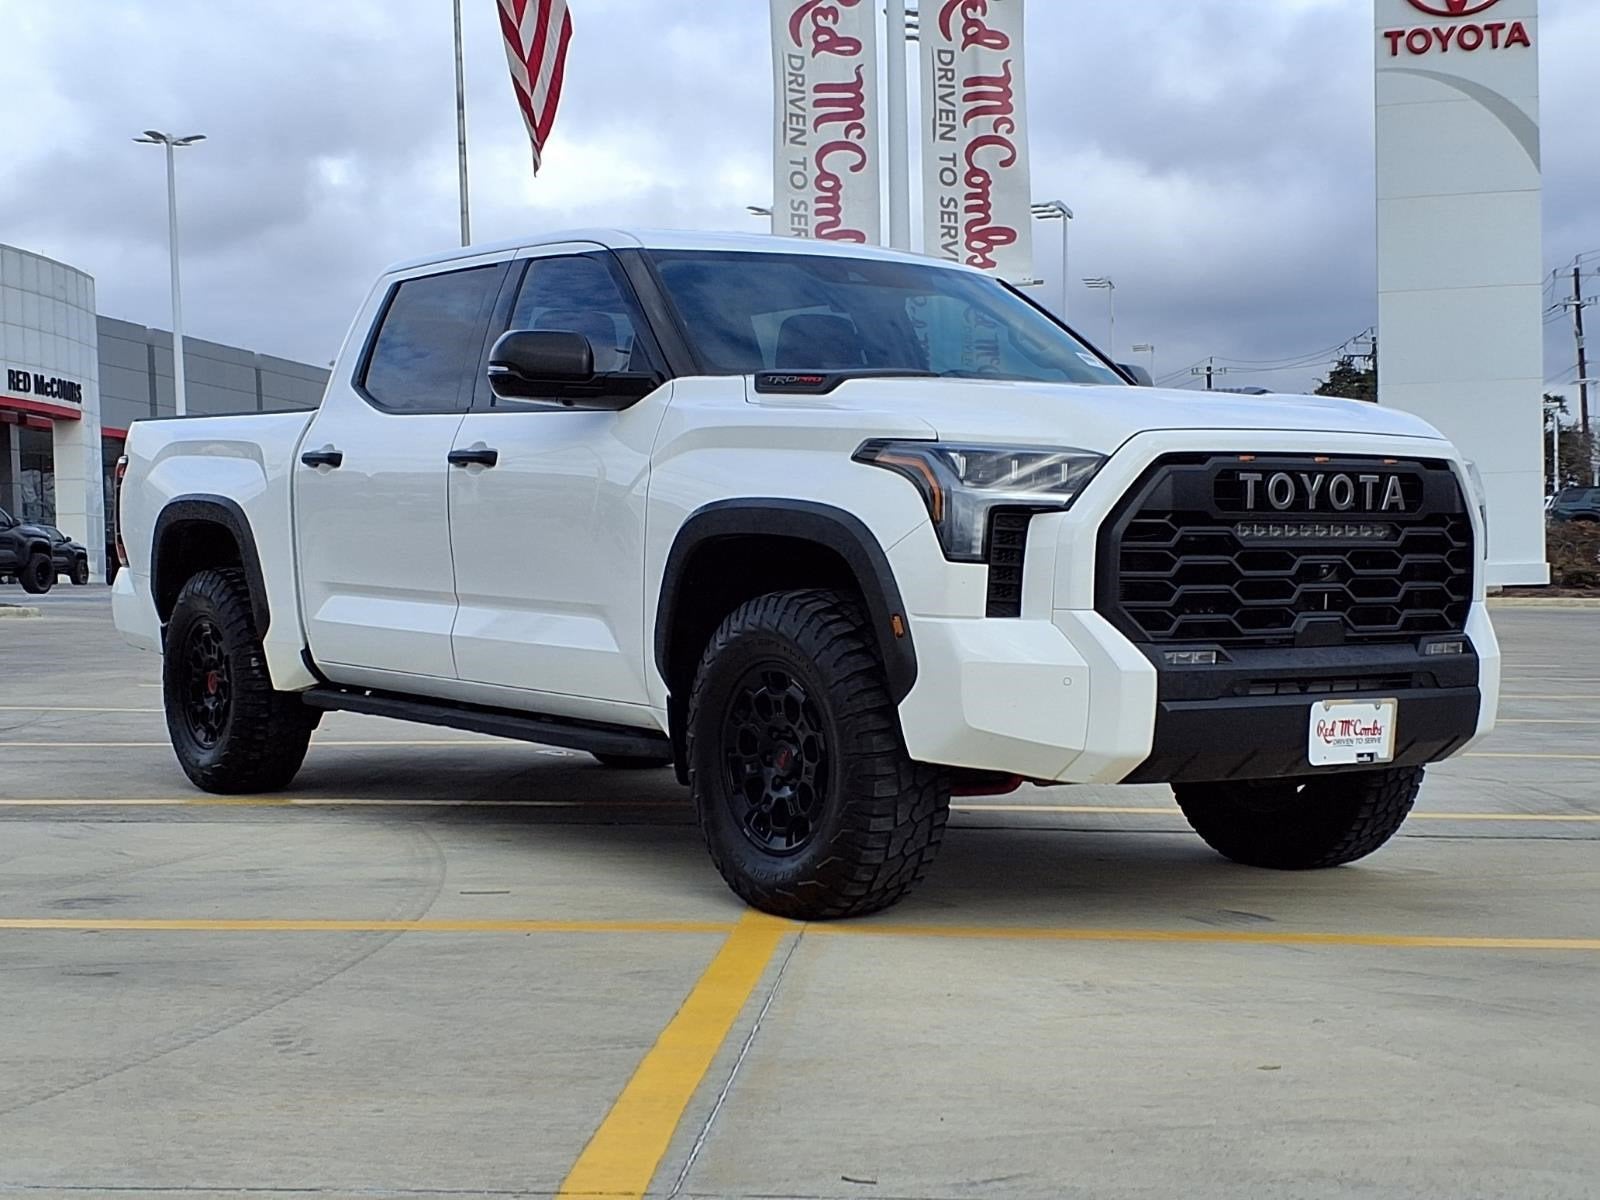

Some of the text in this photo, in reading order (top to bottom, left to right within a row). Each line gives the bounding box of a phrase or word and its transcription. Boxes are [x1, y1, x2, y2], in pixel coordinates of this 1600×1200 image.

[1384, 22, 1531, 56] TOYOTA
[787, 53, 809, 237] DRIVEN TO SER
[812, 64, 867, 243] McCom
[937, 49, 959, 263] DRIVEN TO SERV
[962, 59, 1017, 269] McCombs
[7, 368, 82, 404] RED McCOMBS
[1239, 472, 1406, 511] TOYOTA
[1316, 719, 1383, 744] Red McCombs
